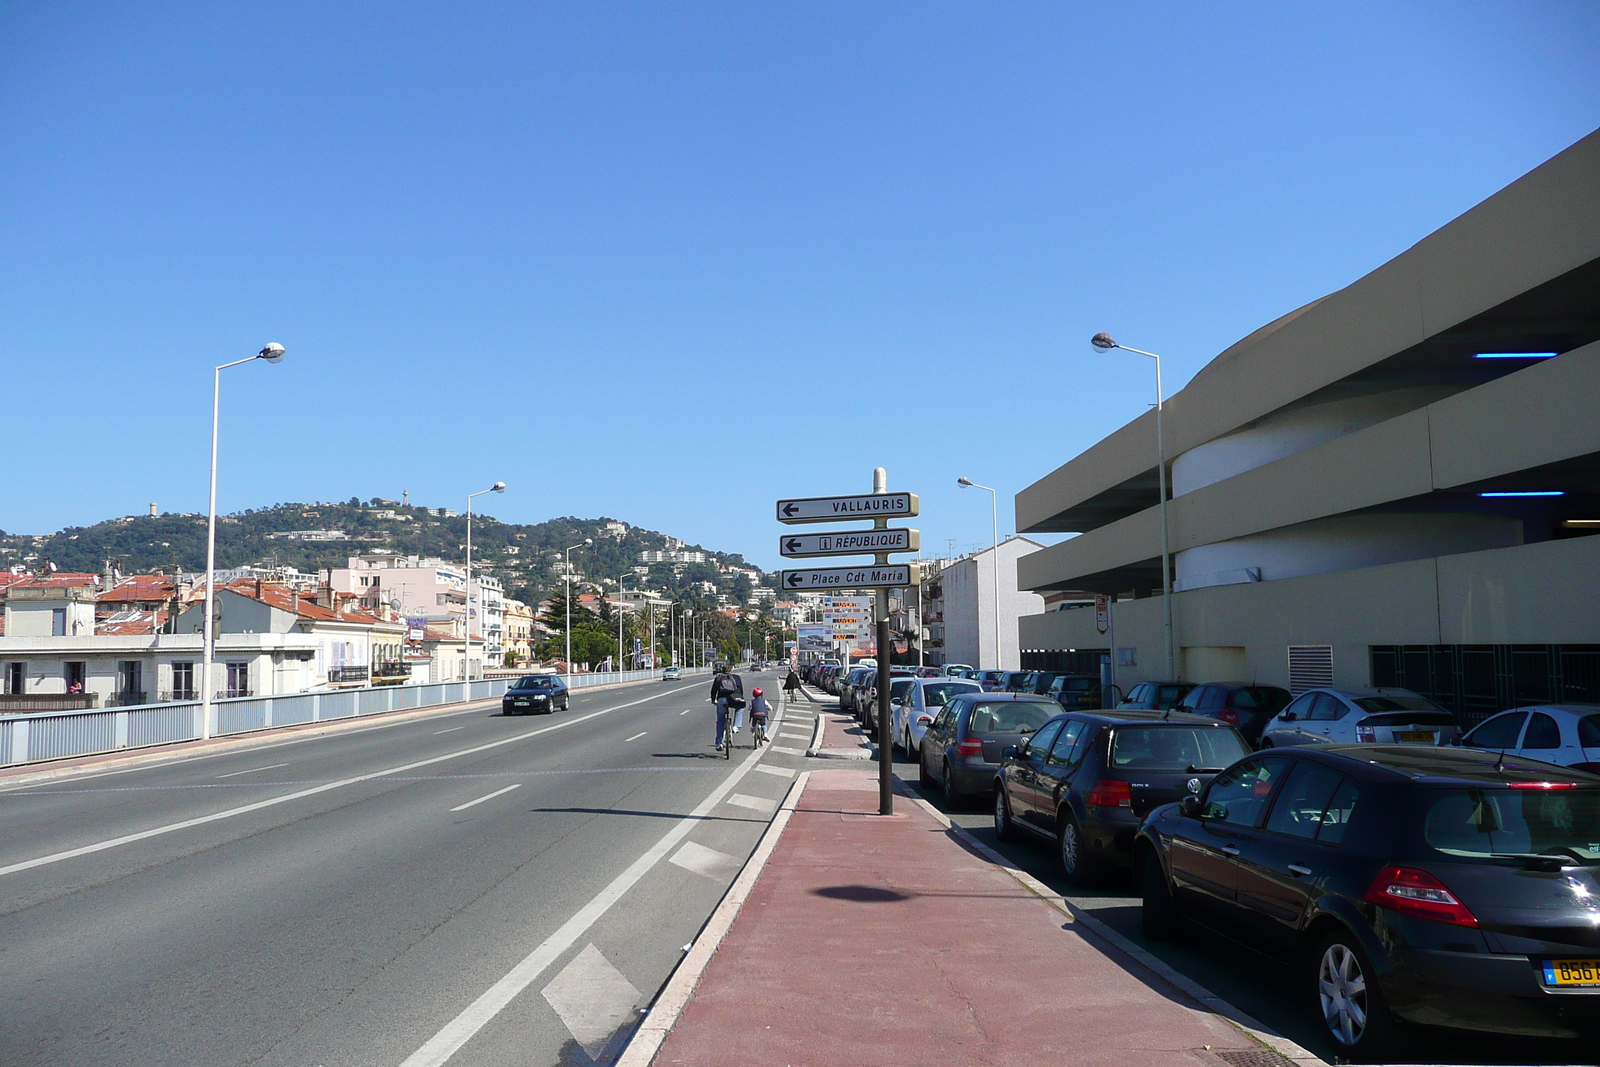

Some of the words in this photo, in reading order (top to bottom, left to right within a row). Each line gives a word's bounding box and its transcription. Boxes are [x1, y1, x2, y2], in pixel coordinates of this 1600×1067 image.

[832, 498, 904, 512] VALLAURIS
[835, 534, 903, 548] RÉPUBLIQUE
[811, 573, 840, 584] Place
[846, 571, 865, 583] Cdt
[870, 570, 903, 582] Maria
[1559, 962, 1593, 981] 856
